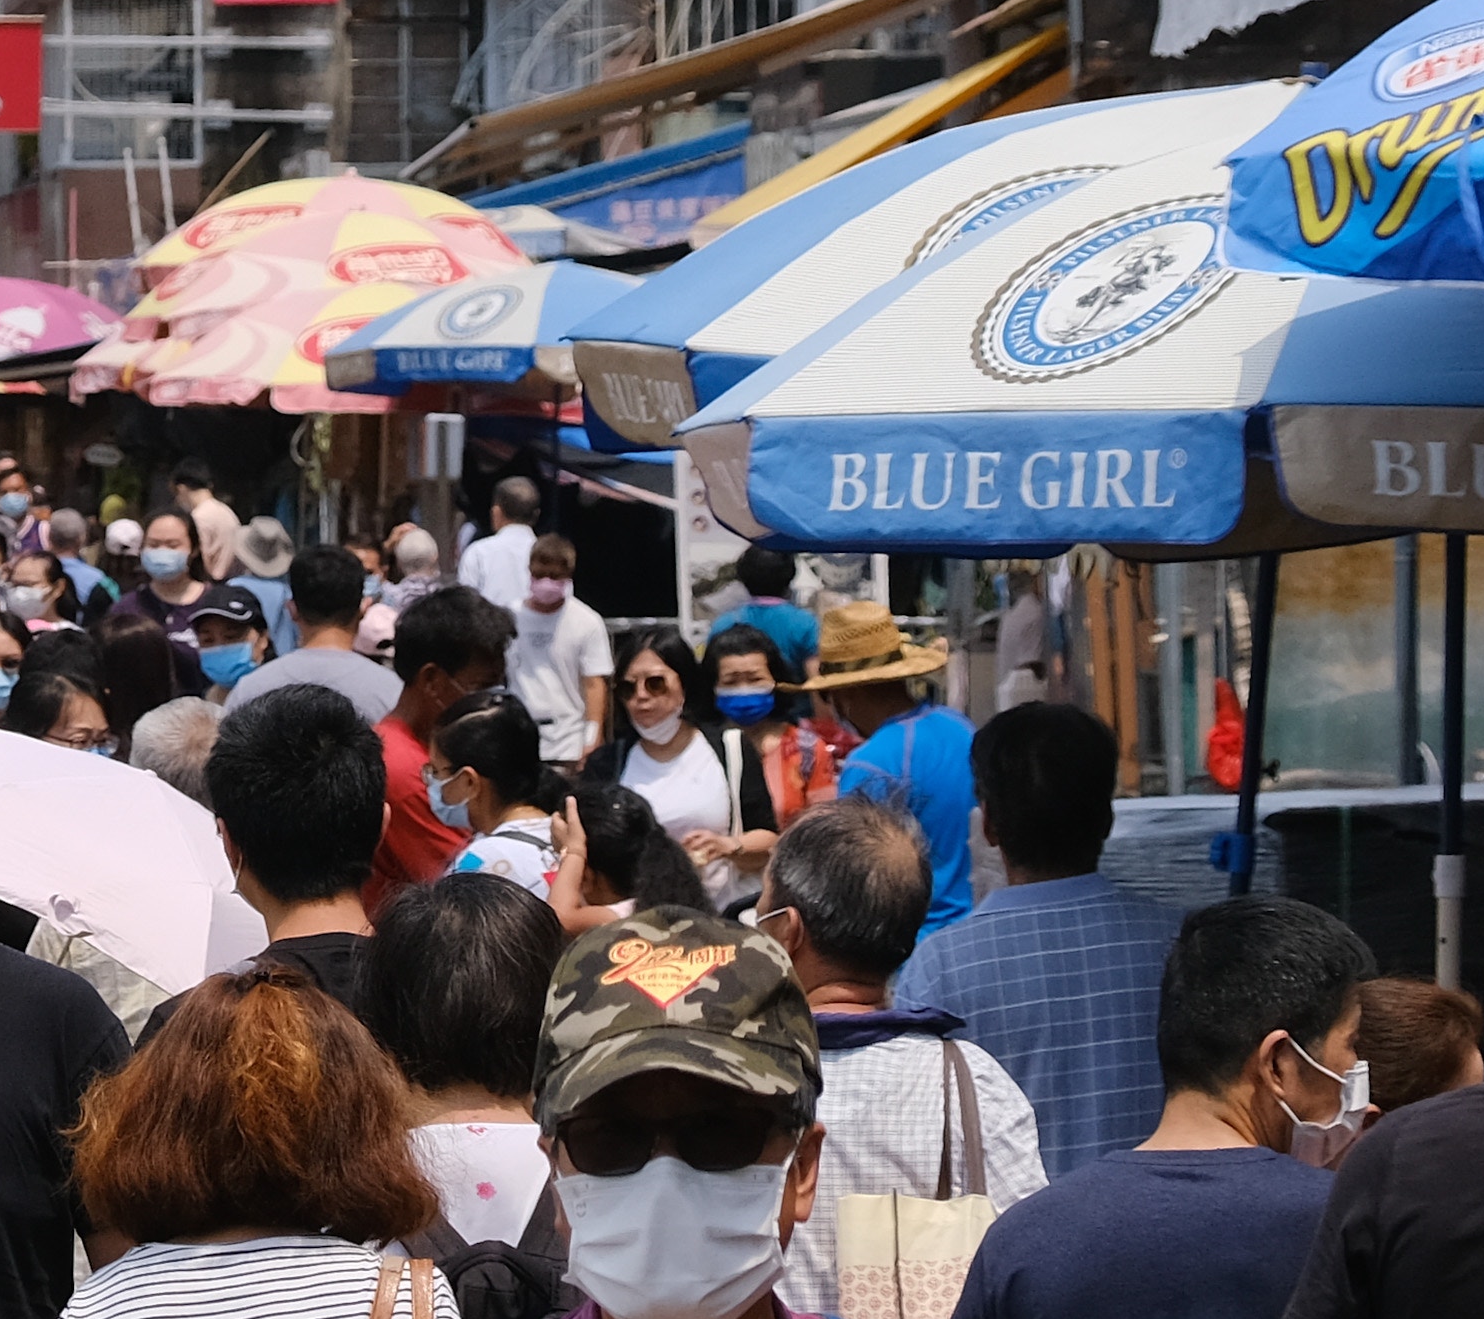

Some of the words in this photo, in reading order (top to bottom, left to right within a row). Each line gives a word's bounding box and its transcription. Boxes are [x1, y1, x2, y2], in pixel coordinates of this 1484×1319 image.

[1066, 209, 1187, 265] PILSENER
[1043, 327, 1133, 364] LAGER
[1133, 289, 1194, 331] BIER
[829, 449, 1003, 512] BLUE
[1019, 449, 1177, 510] GIRL
